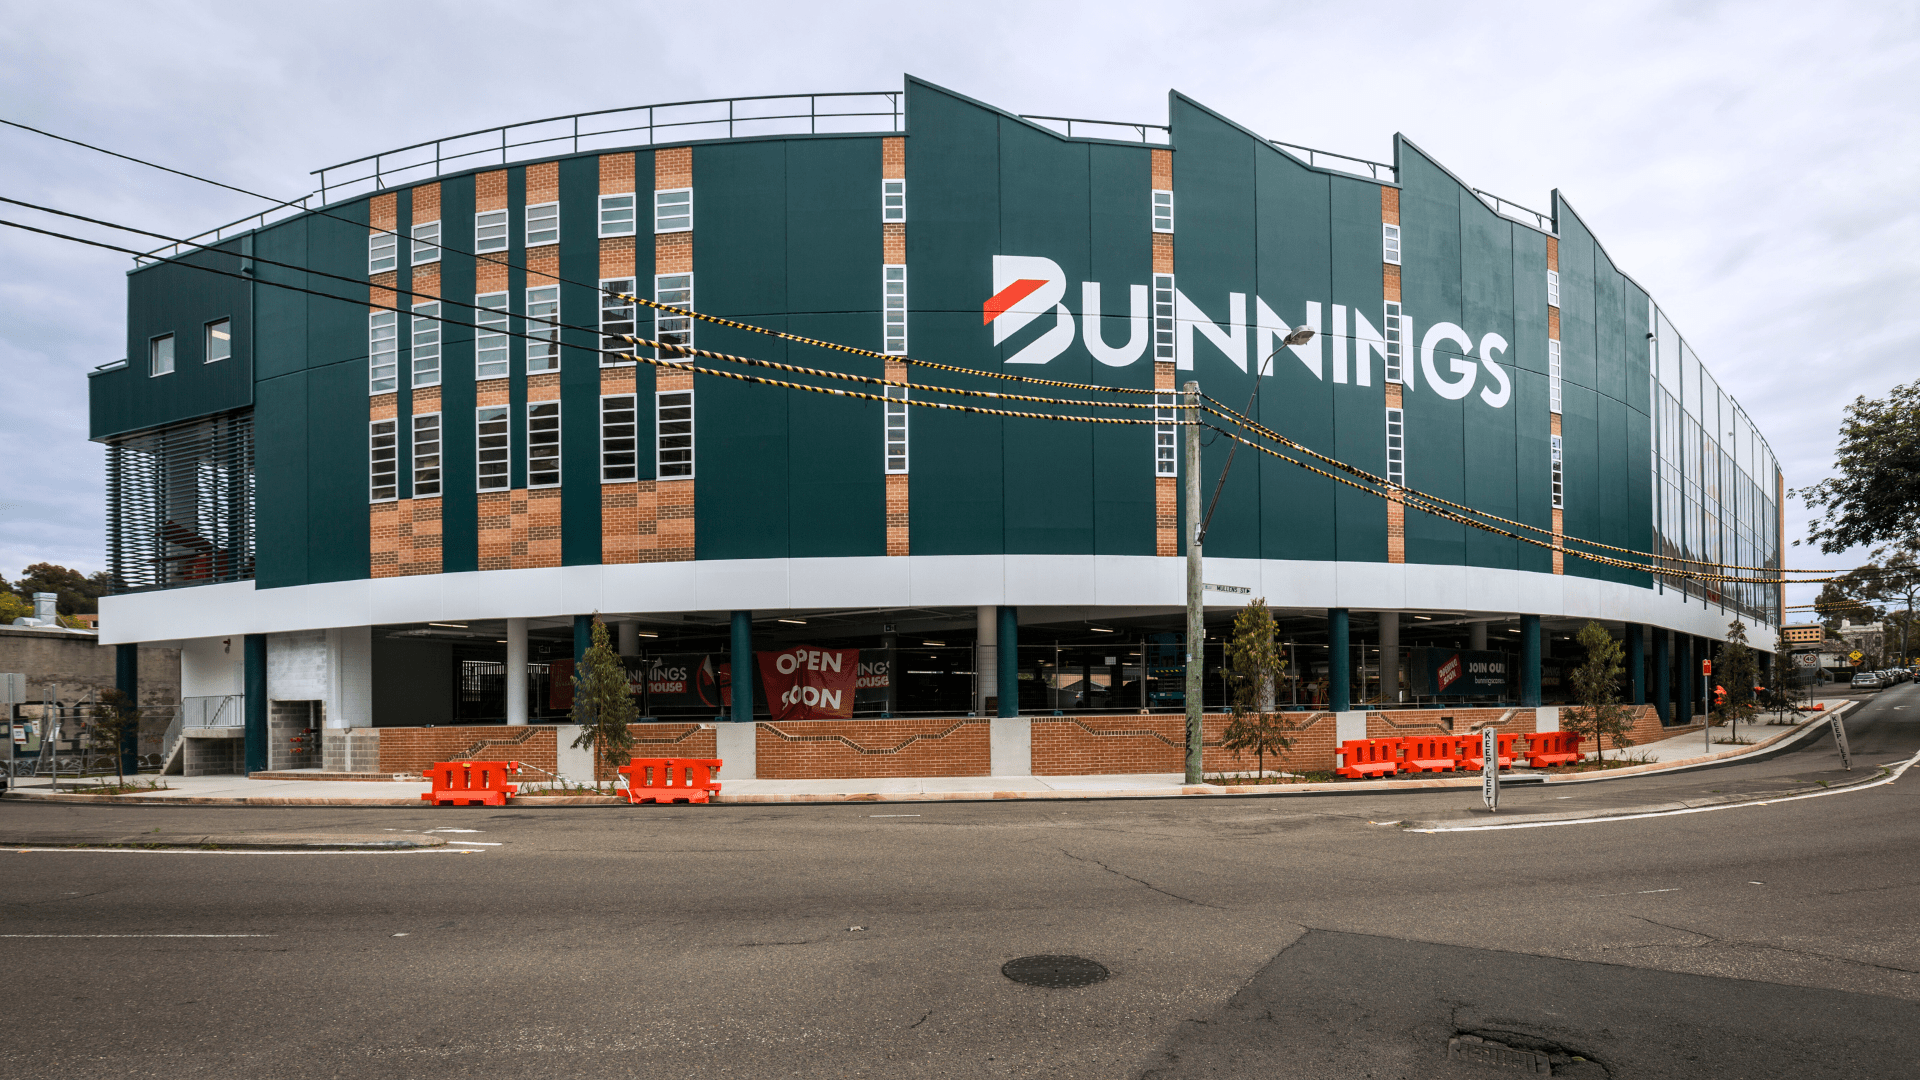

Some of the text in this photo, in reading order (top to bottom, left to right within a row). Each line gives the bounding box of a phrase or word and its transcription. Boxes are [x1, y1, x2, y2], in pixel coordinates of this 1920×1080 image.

[983, 254, 1511, 408] BUNNINGS
[1216, 584, 1238, 594] MULLENS
[1240, 587, 1246, 595] ST
[776, 649, 842, 675] OPEN
[1468, 662, 1488, 674] JOIN
[781, 684, 842, 710] SOON
[1831, 717, 1842, 740] KEEP
